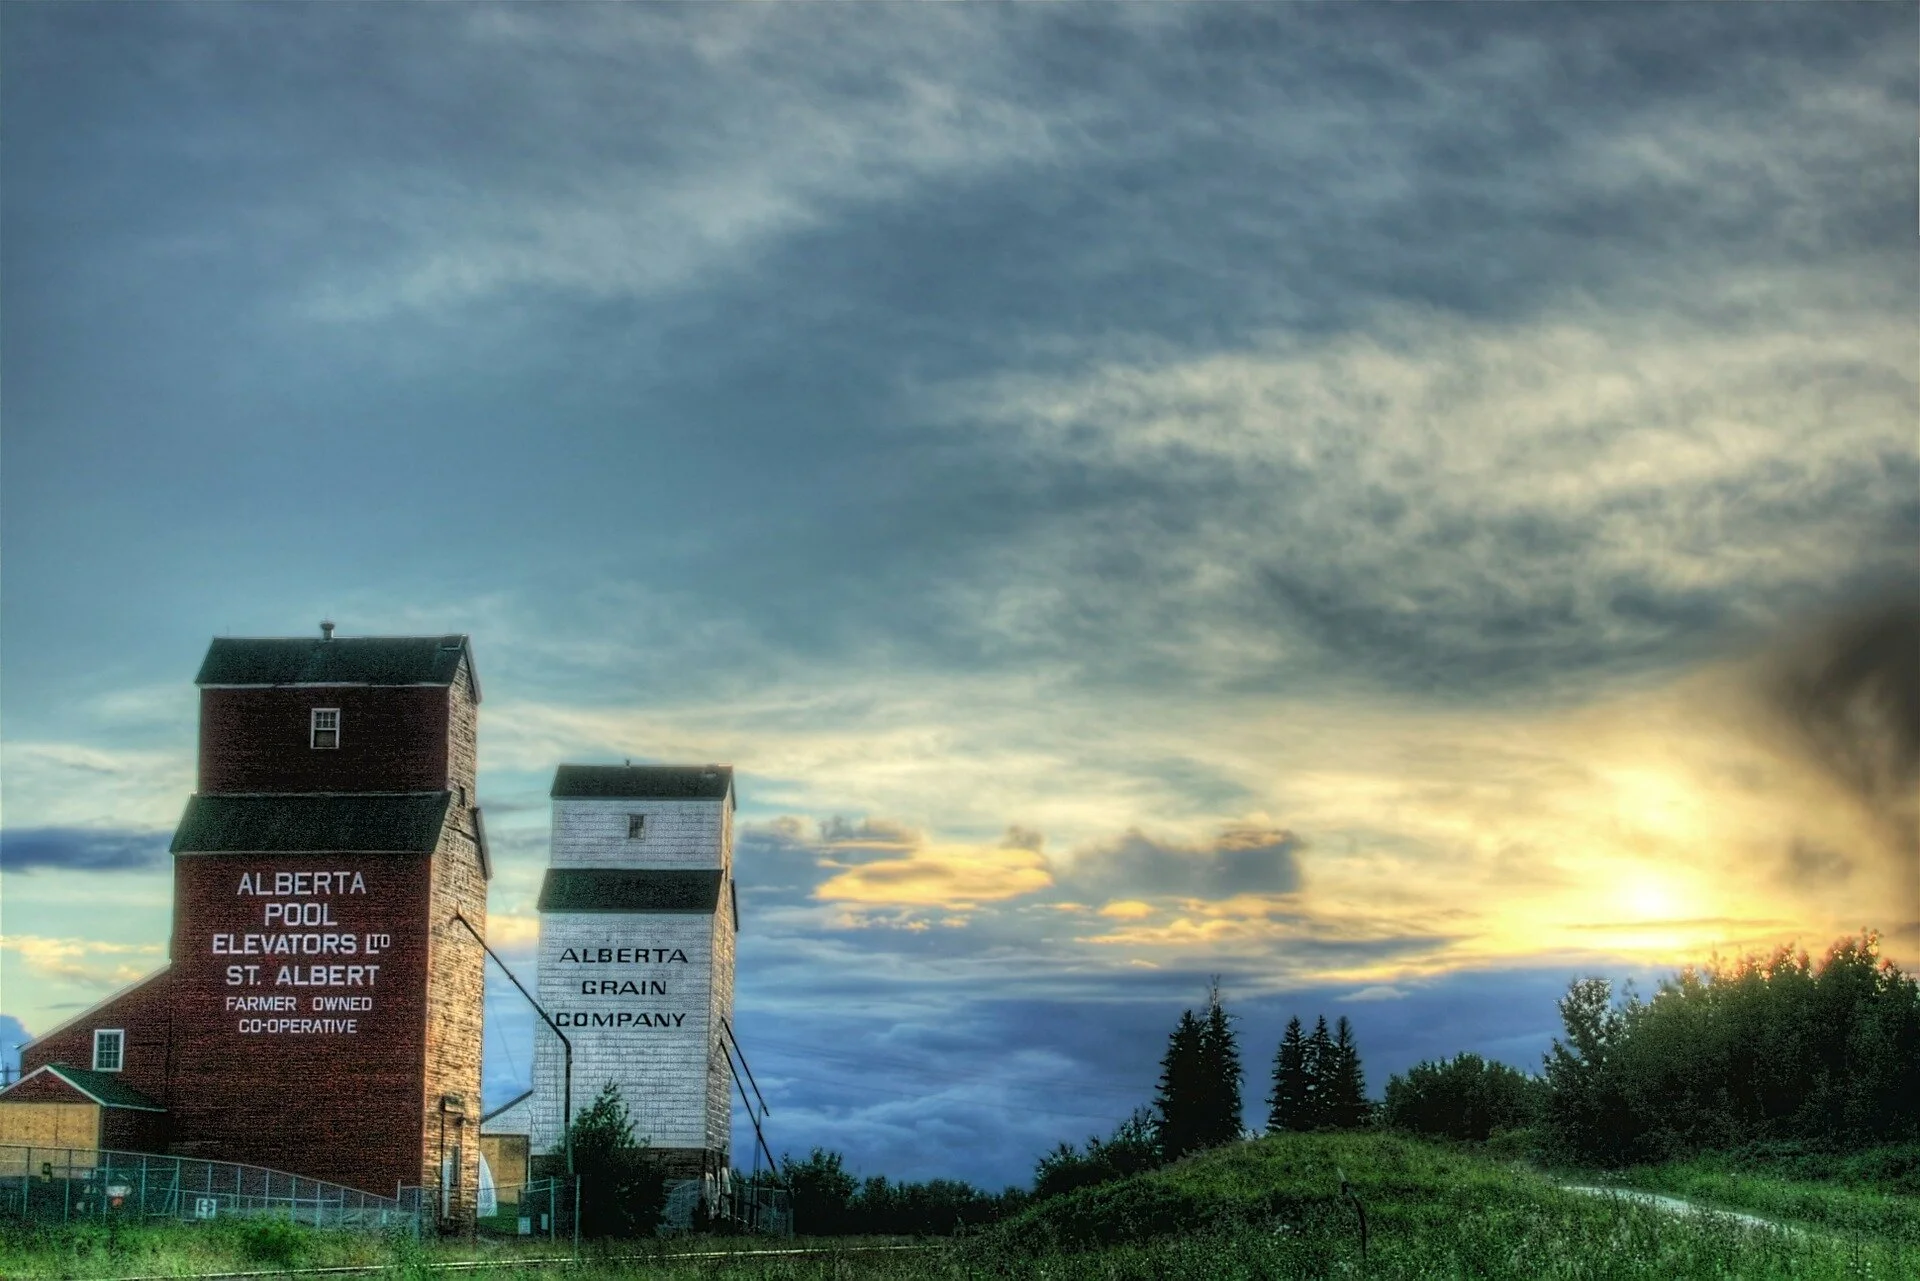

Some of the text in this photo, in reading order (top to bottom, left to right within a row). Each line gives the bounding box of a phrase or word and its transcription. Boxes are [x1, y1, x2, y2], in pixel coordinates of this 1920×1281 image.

[237, 871, 367, 896] ALBERTA
[264, 903, 338, 927] POOL
[212, 933, 357, 955] ELEVATORS
[559, 948, 689, 964] ALBERTA
[226, 965, 380, 986] ST. ALBERT
[581, 980, 667, 996] GRAIN
[226, 996, 373, 1012] FARMER OWNED
[239, 1019, 358, 1034] CO-OPERATIVE
[555, 1012, 687, 1028] COMPANY
